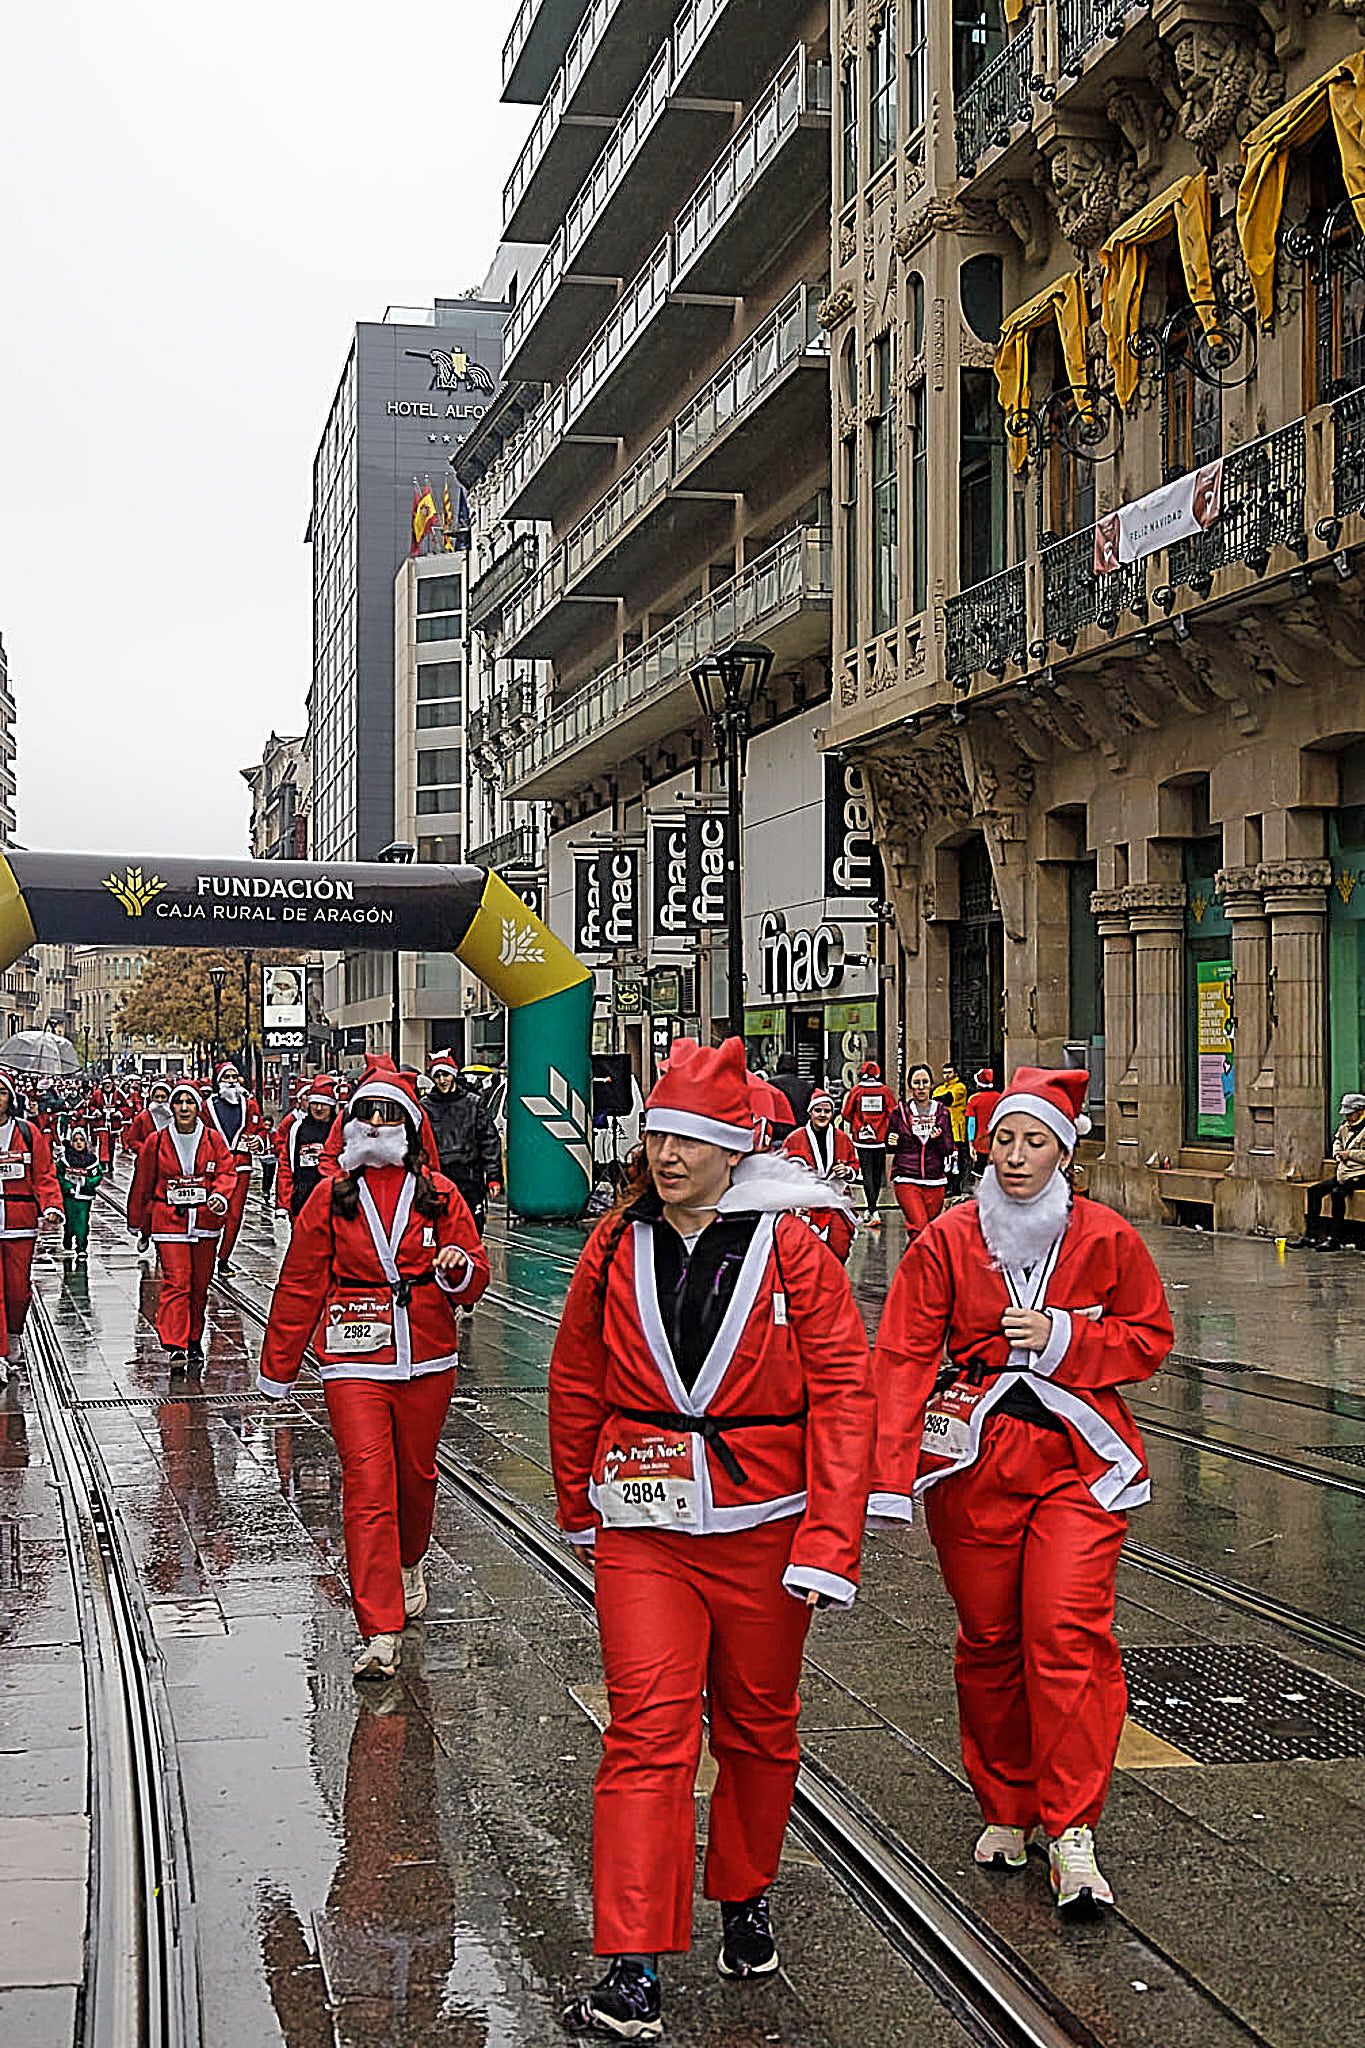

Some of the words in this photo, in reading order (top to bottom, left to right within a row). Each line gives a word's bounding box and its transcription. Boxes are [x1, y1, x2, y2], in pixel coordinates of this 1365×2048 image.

[387, 401, 438, 417] HOTEL
[445, 404, 489, 420] ALFO
[1150, 509, 1182, 532] NAVIDAD
[660, 832, 686, 931] fnac
[692, 819, 724, 923] fnac
[197, 875, 354, 900] FUNDACIÓN
[605, 855, 632, 943] fnac
[156, 903, 206, 919] CAJA
[213, 905, 276, 921] RURAL
[283, 908, 307, 921] DE
[314, 906, 393, 923] ARAGÓN
[759, 910, 839, 994] fnac
[266, 1031, 304, 1048] 10:32
[343, 1325, 371, 1339] 2982
[622, 1482, 666, 1504] 2984
